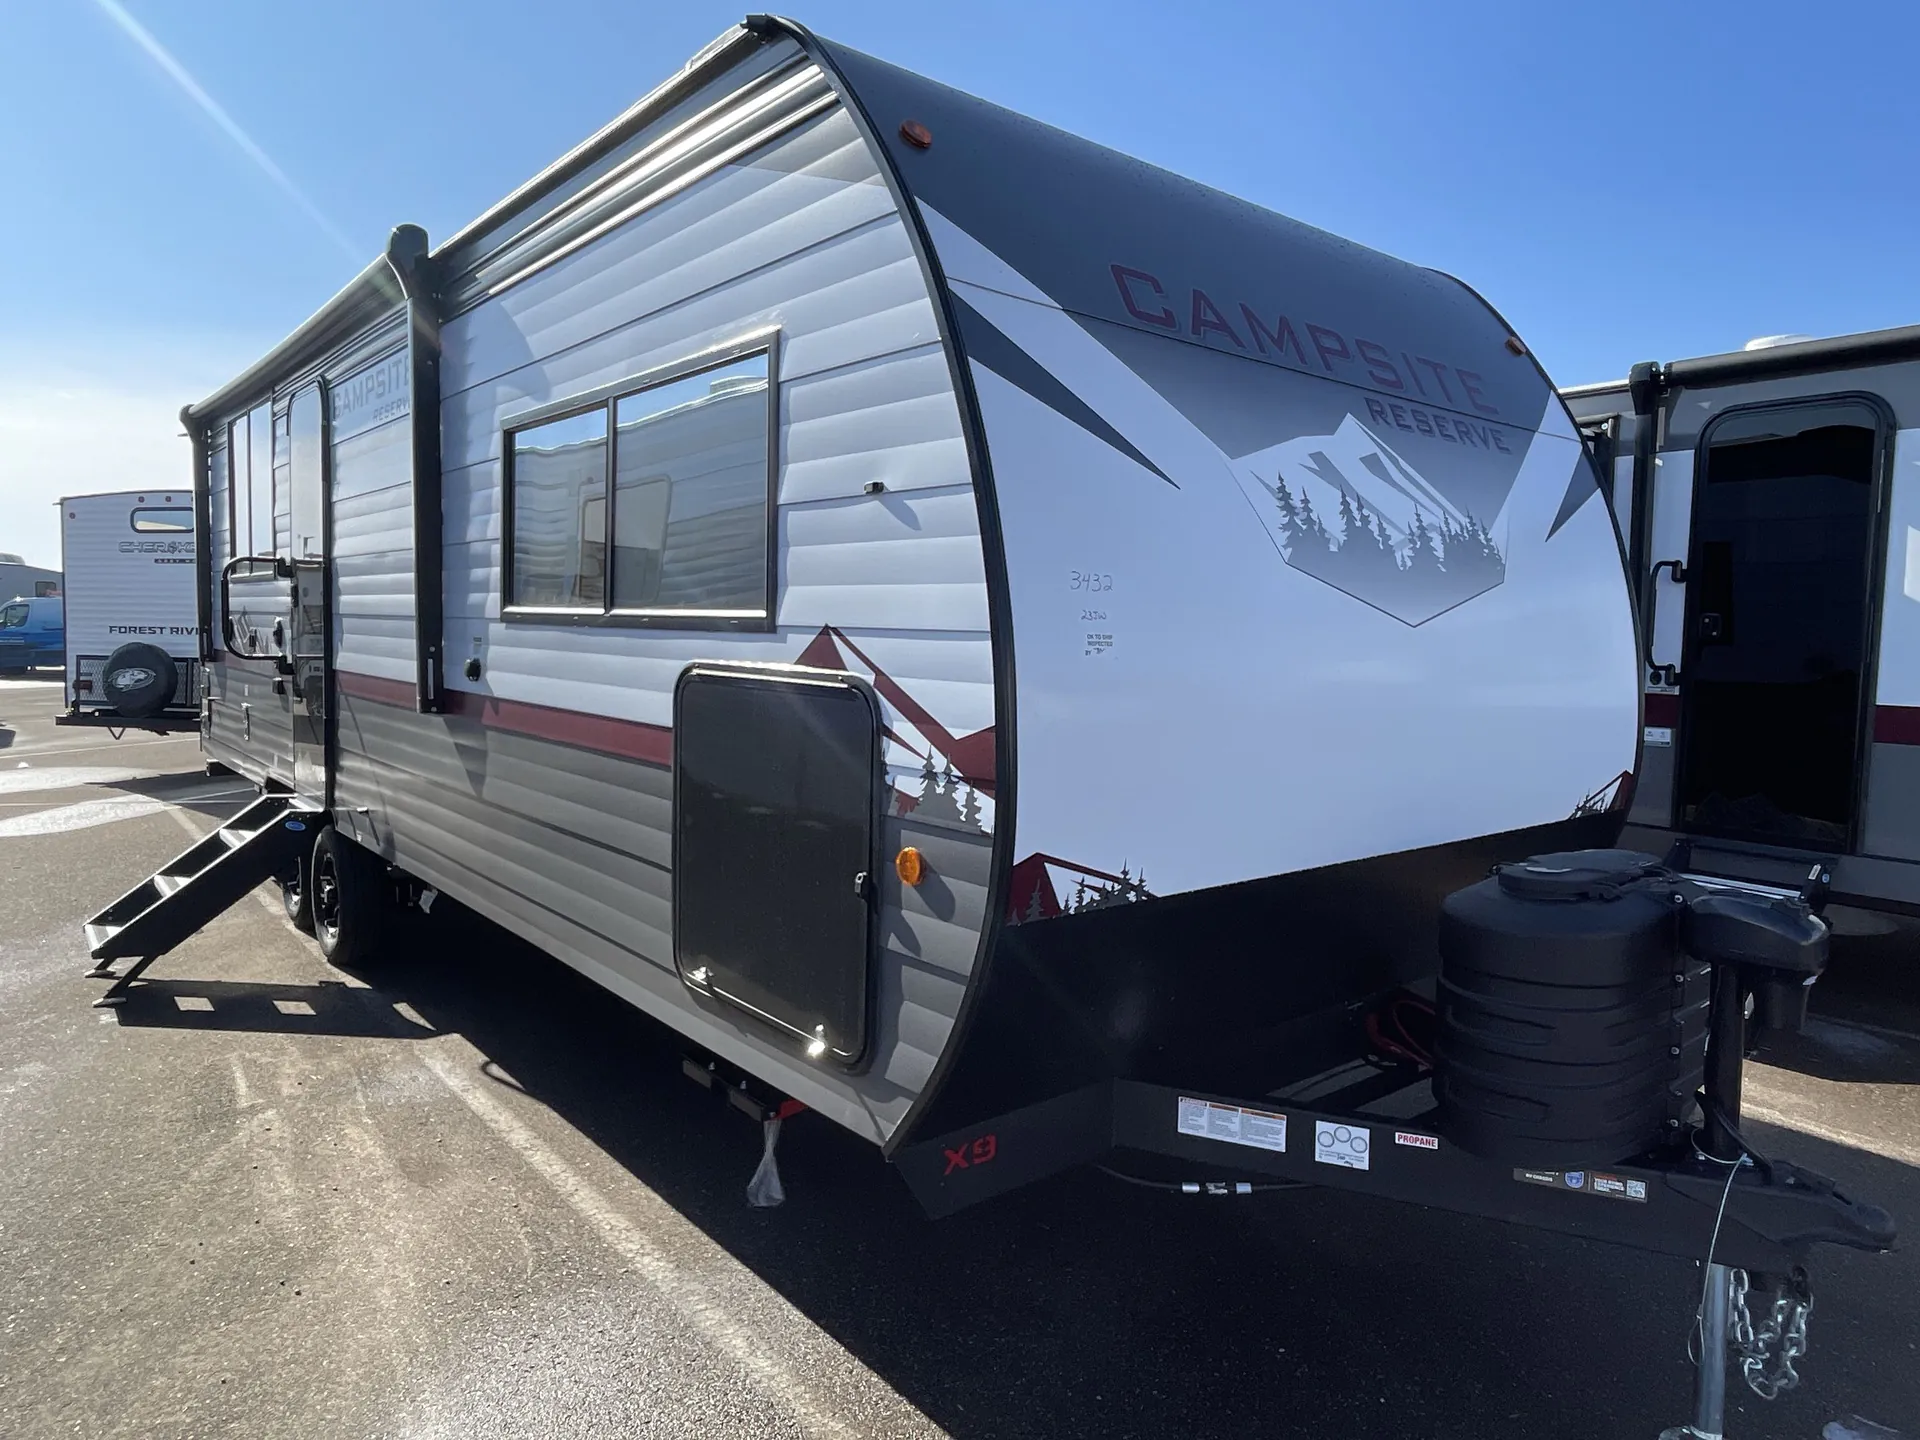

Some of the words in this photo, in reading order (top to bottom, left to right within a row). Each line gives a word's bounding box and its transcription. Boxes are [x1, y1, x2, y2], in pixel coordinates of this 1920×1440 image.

[1110, 264, 1499, 415] CAMPSITE
[1363, 397, 1511, 454] RESERVE
[1070, 570, 1113, 592] 3432
[108, 625, 167, 635] FOREST
[943, 1132, 997, 1176] X9
[1397, 1133, 1437, 1148] PROPANE
